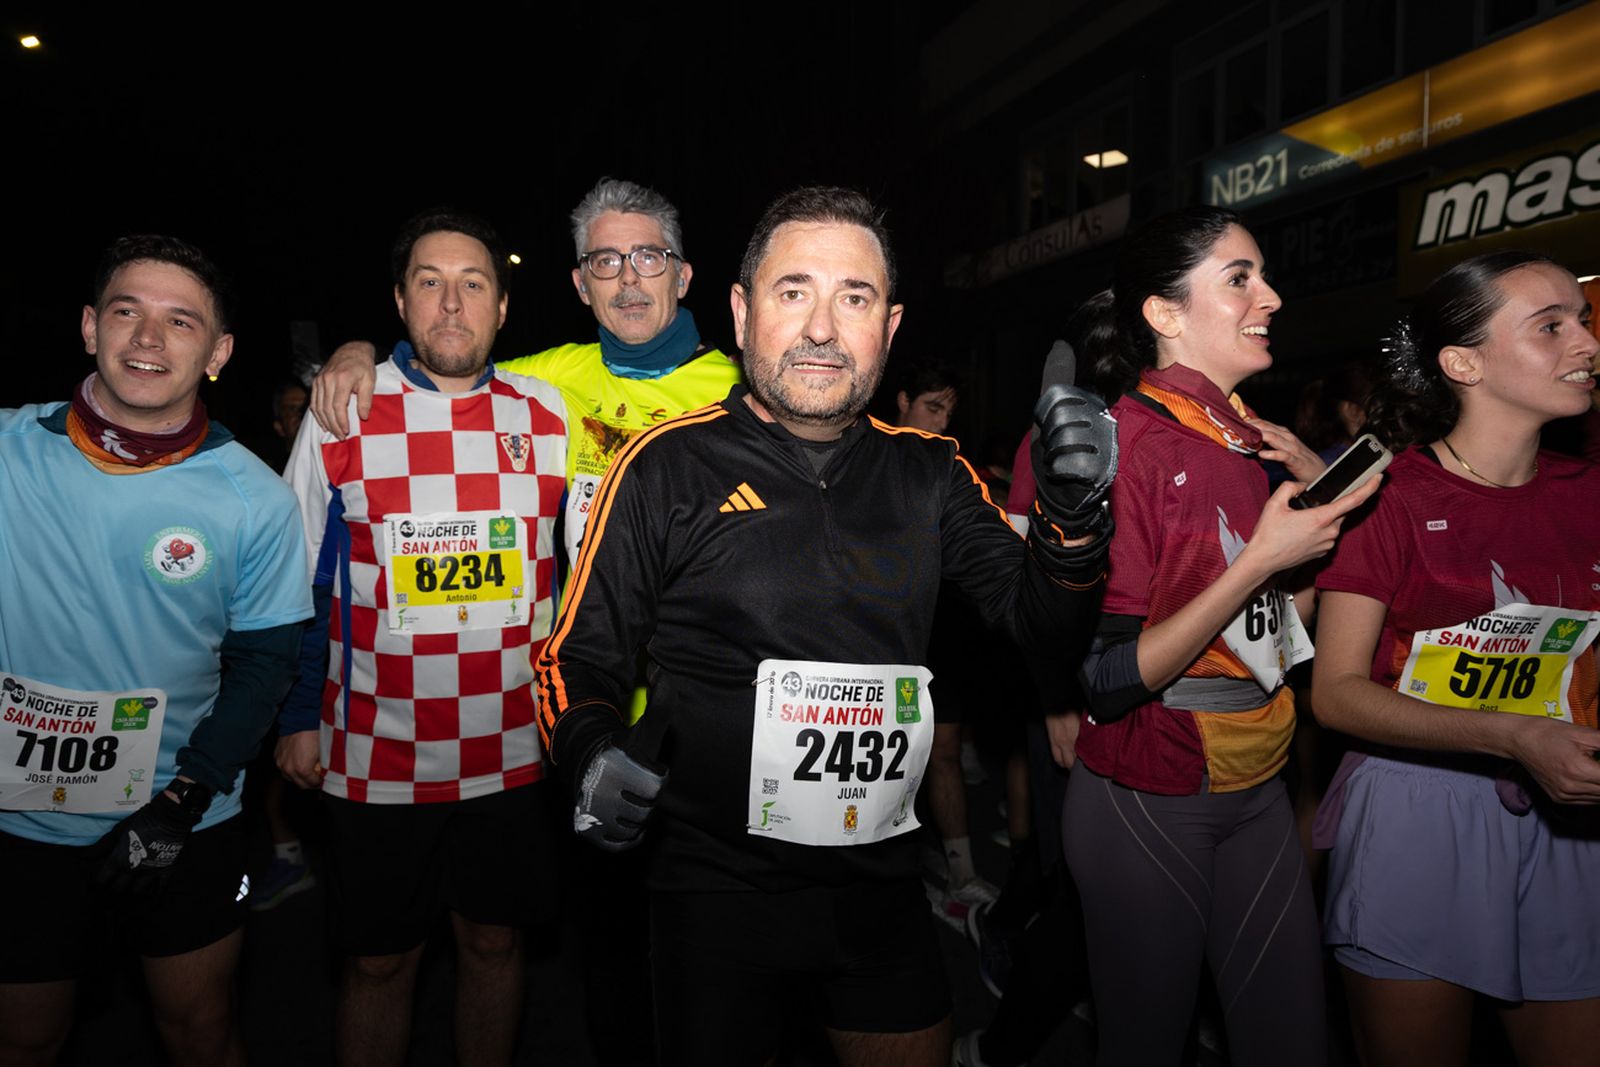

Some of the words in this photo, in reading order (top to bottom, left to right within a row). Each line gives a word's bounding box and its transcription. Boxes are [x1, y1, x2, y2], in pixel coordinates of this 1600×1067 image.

[1376, 136, 1395, 154] de
[1210, 147, 1290, 207] NB21
[417, 526, 459, 538] NOCHE
[462, 524, 477, 536] DE
[402, 541, 430, 555] SAN
[432, 536, 478, 554] ANTÓN
[415, 553, 506, 593] 8234
[446, 593, 478, 603] Antonio
[1466, 616, 1521, 635] NOCHE
[1518, 621, 1540, 635] DE
[1438, 630, 1480, 651] SAN
[1480, 634, 1531, 654] ANTÓN
[783, 677, 801, 690] 43
[1449, 651, 1541, 700] 5718
[11, 686, 25, 700] 43
[805, 682, 863, 703] NOCHE
[865, 685, 885, 702] DE
[26, 695, 76, 717] NOCHE
[77, 704, 99, 718] DE
[780, 703, 820, 724] SAN
[822, 703, 884, 727] ANTÓN
[4, 706, 35, 728] SAN
[35, 717, 97, 735] ANTÓN
[15, 729, 119, 773] 7108
[793, 728, 909, 783] 2432
[25, 772, 53, 784] JOSÉ
[56, 772, 98, 785] RAMÓN
[837, 787, 867, 800] JUAN
